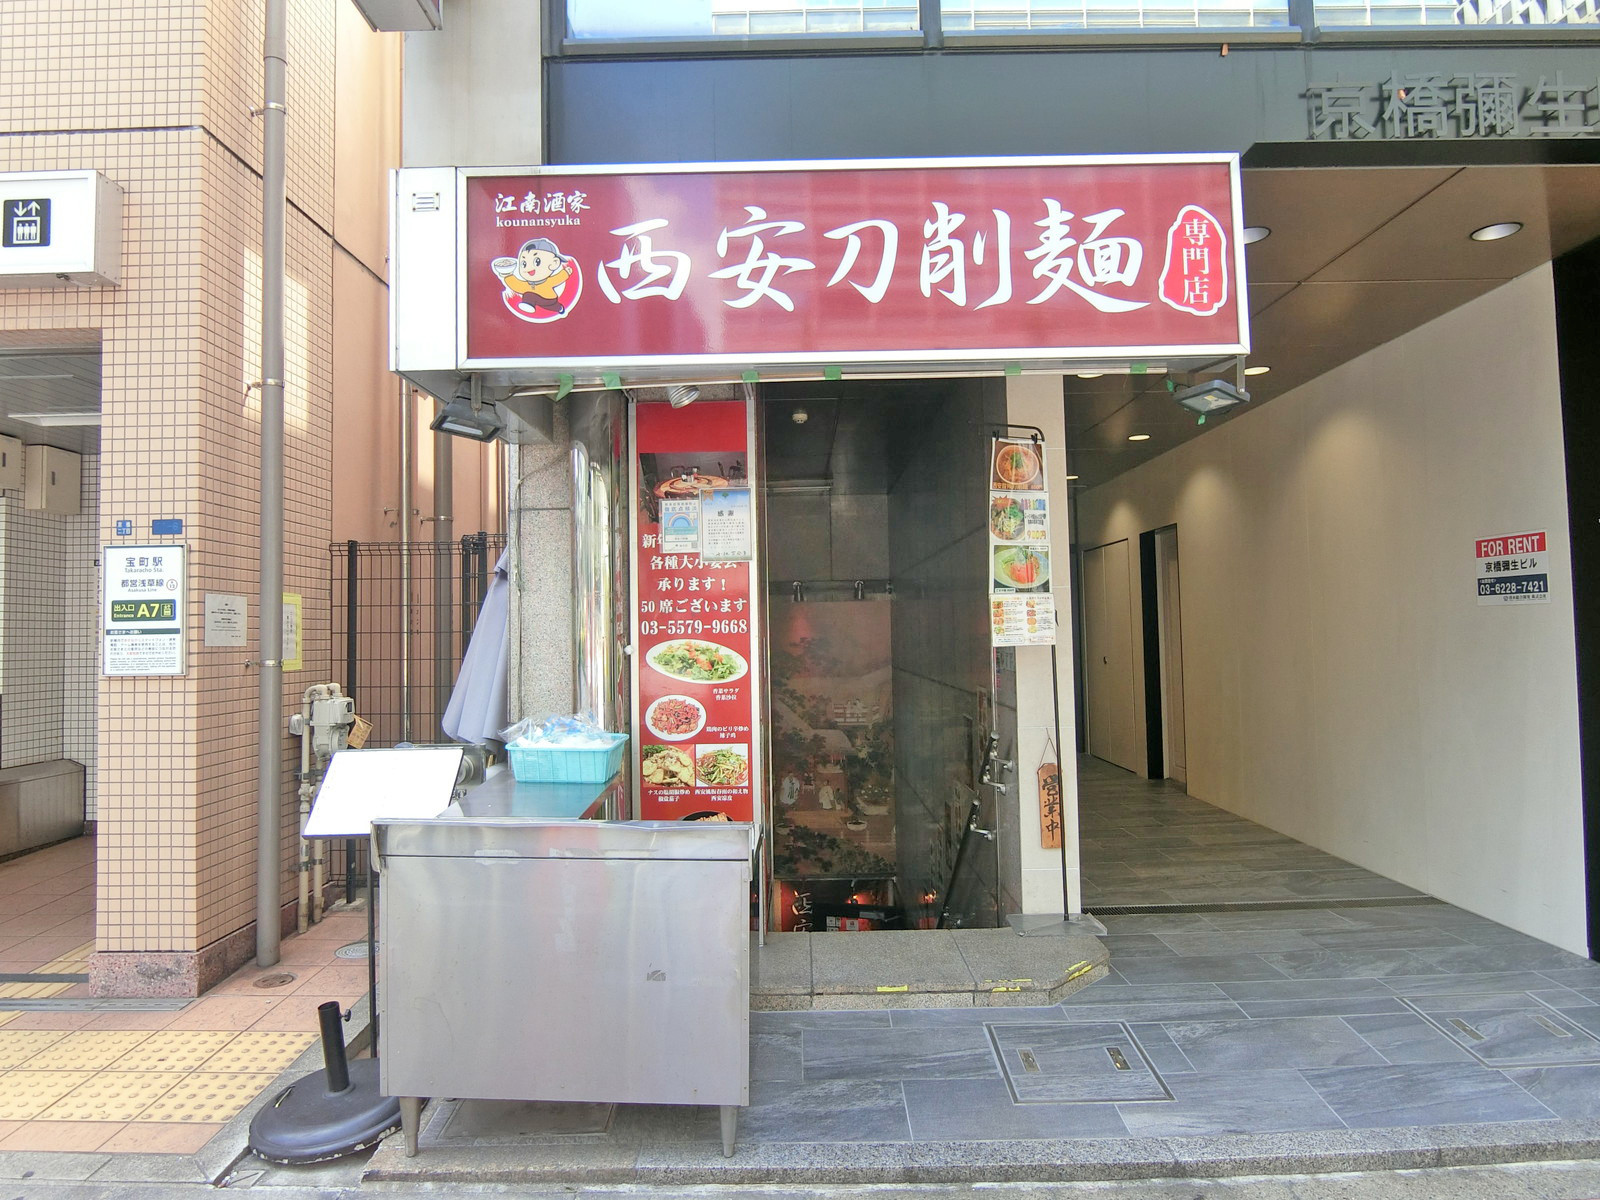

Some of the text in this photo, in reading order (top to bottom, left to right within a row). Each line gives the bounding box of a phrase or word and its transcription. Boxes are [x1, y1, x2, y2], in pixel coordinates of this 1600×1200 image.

[1305, 71, 1600, 138] 京橋彌生
[495, 190, 590, 214] 江南酒家
[495, 214, 581, 229] kounansyuka
[1481, 535, 1540, 558] FOR RENT
[125, 556, 163, 567] 宝町駅
[121, 578, 164, 588] 都営浅草線
[1480, 580, 1544, 595] 03-6228-7421
[113, 603, 160, 618] 出入口 A7
[641, 619, 748, 635] 03-5579-9668
